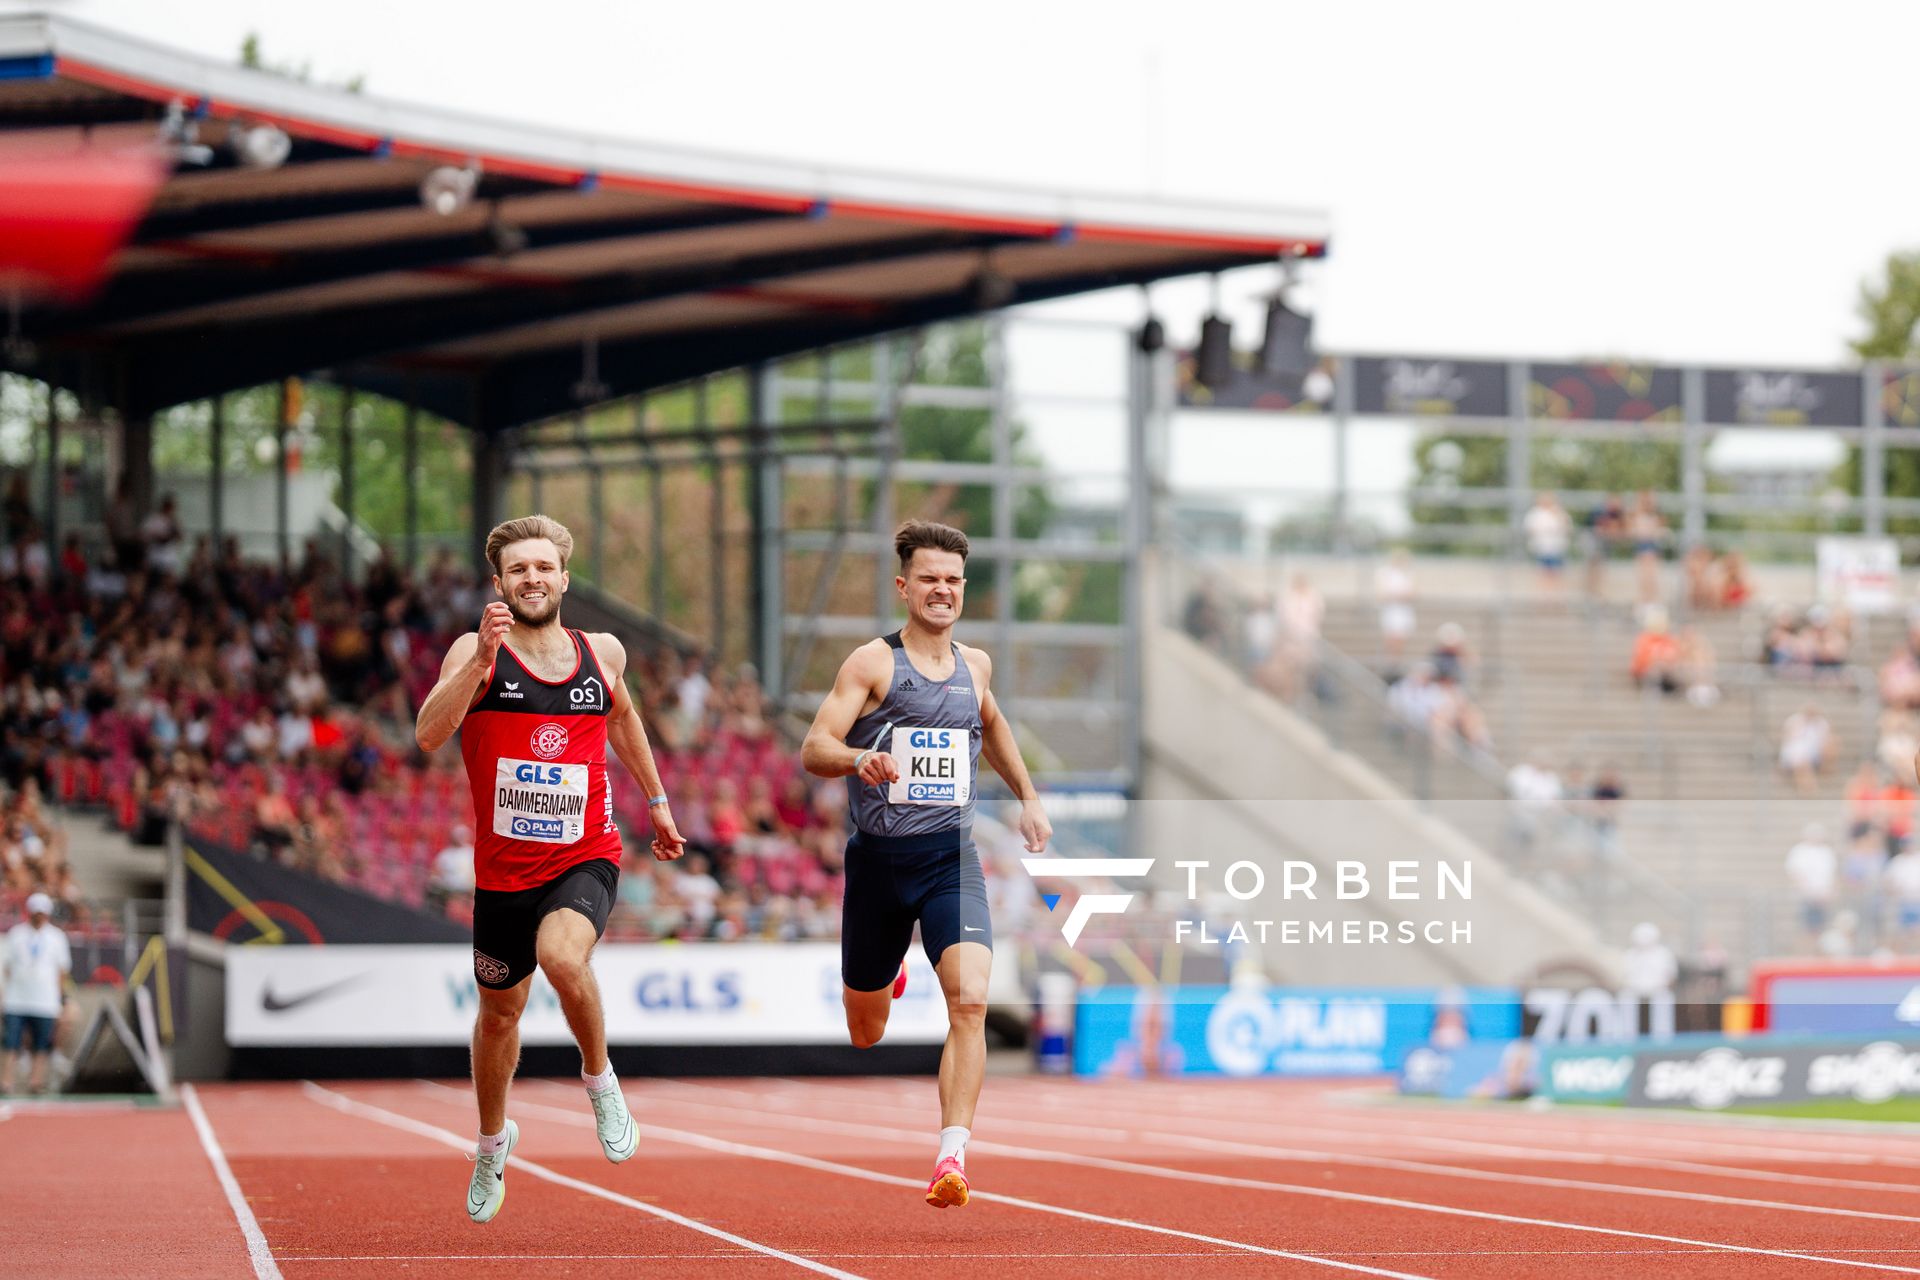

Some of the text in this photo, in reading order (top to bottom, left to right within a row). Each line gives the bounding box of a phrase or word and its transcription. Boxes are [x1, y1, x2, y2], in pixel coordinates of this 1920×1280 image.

[500, 691, 524, 699] erima
[570, 688, 595, 703] OS
[911, 756, 955, 778] KLEI
[927, 786, 954, 795] PLAN
[499, 787, 584, 815] DAMMERMANN
[532, 822, 561, 833] PLAN
